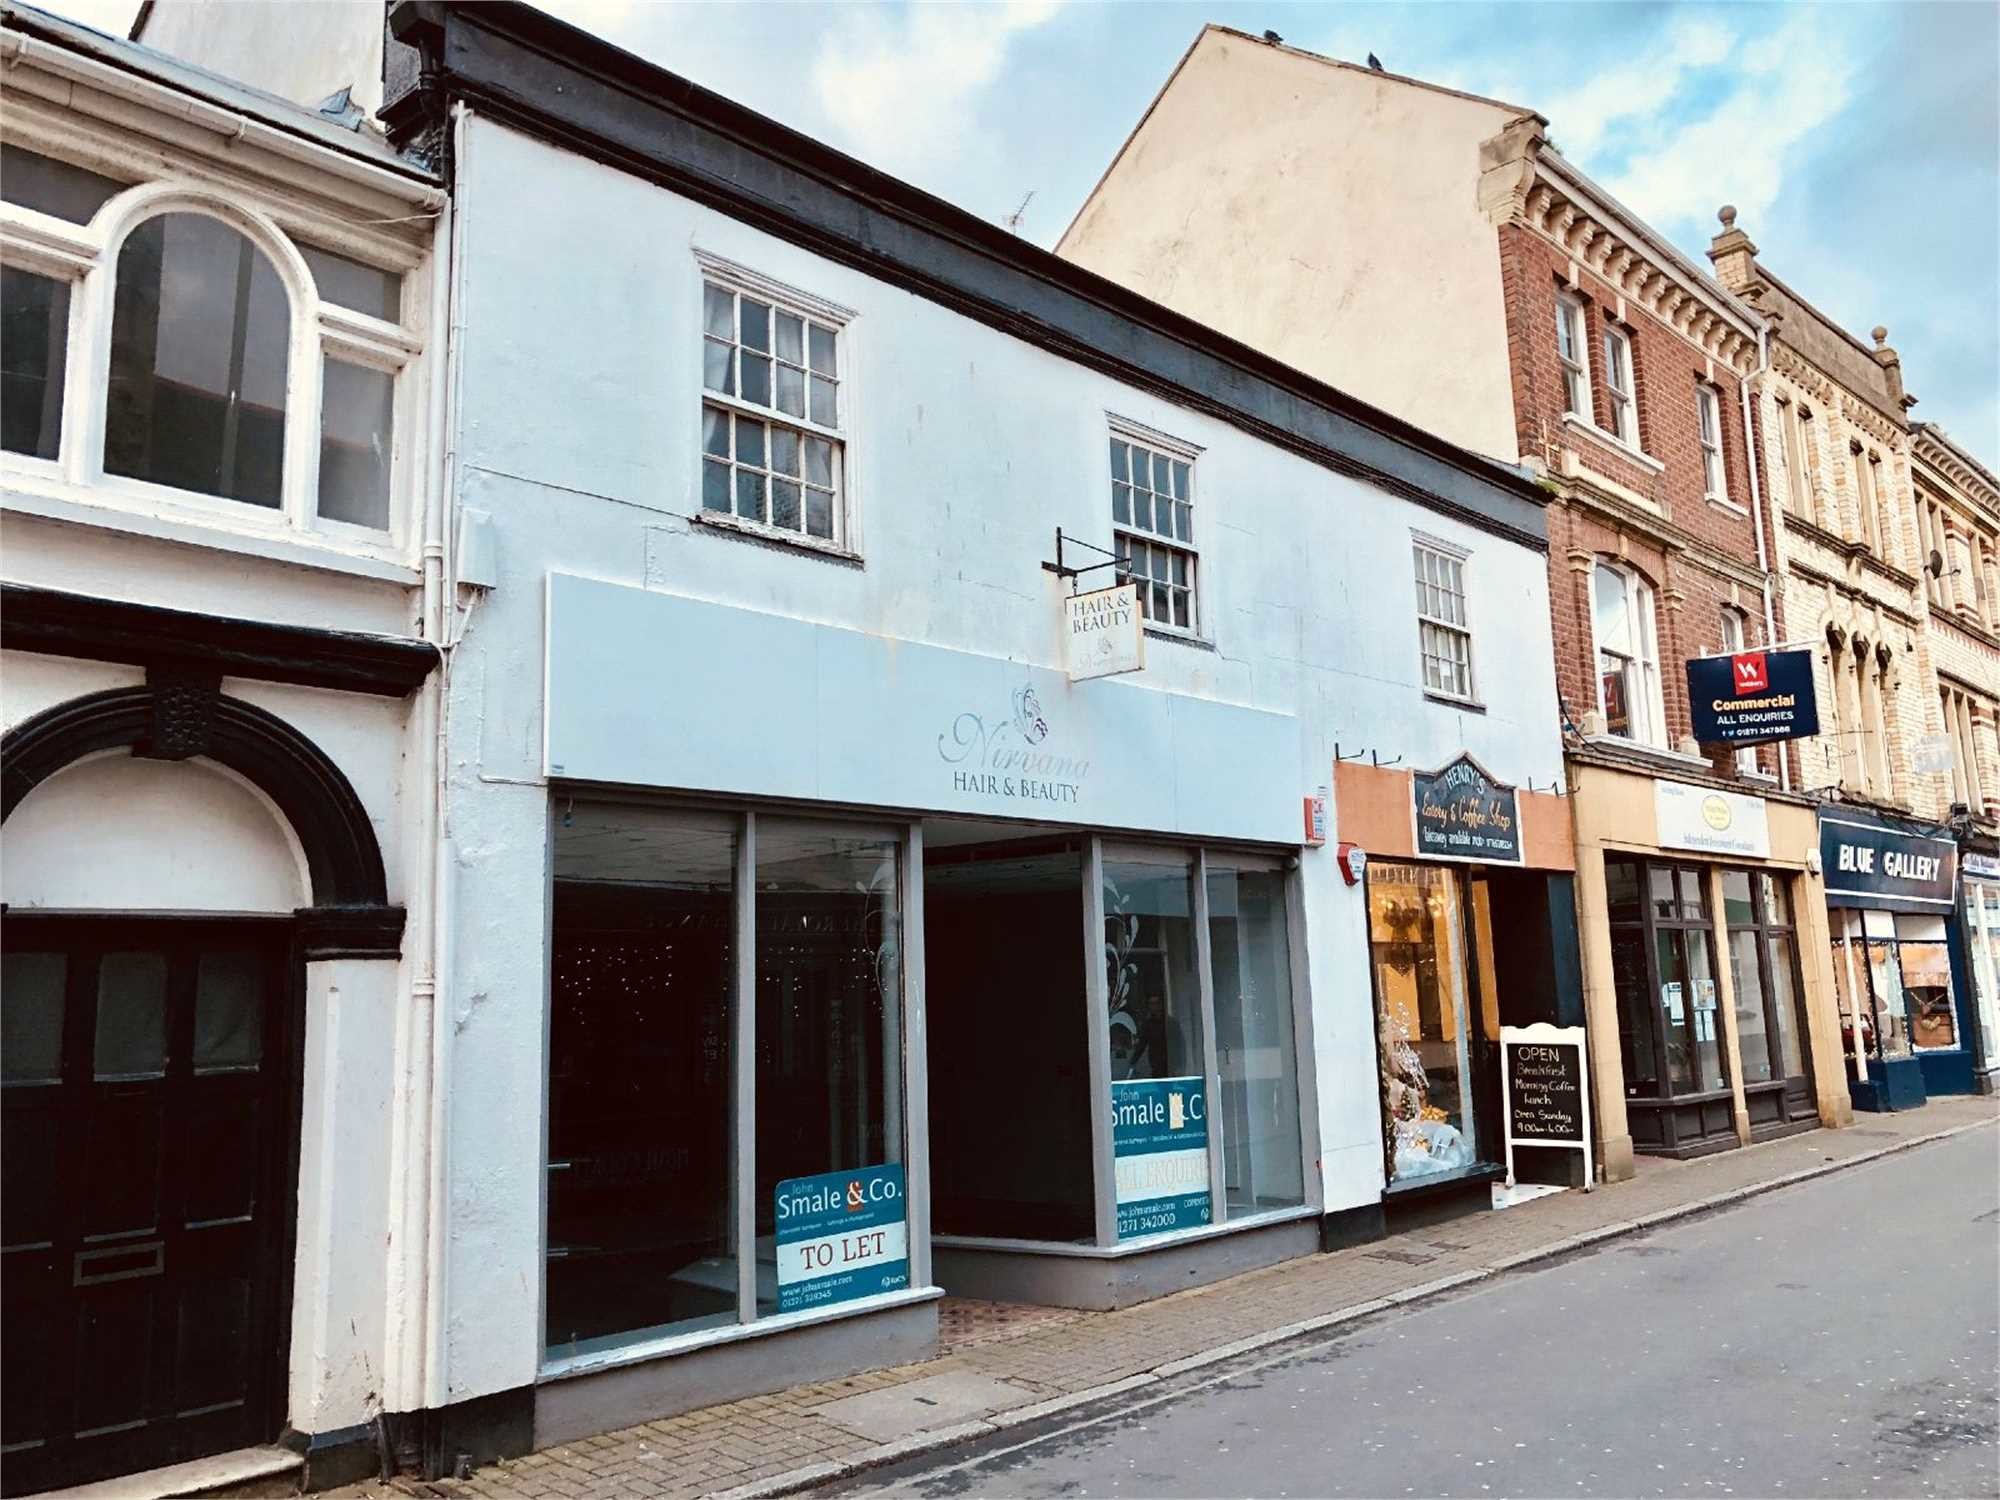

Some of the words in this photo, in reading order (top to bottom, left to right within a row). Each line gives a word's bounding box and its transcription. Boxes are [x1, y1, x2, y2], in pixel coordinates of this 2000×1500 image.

[1074, 595, 1113, 617] HAIR
[1117, 591, 1129, 607] &
[1073, 608, 1131, 634] BEAUTY
[1712, 694, 1795, 711] Commercial
[1717, 715, 1736, 725] ALL
[1739, 711, 1794, 723] ENQUIRIES
[938, 713, 1090, 777] Nirvana
[953, 771, 999, 795] HAIR
[1003, 777, 1016, 797] &
[1021, 778, 1079, 803] BEAUTY
[1445, 763, 1486, 795] HENRY'S
[1459, 796, 1486, 829] Coffee
[1489, 799, 1511, 832] Shop
[1839, 844, 1874, 874] BLUE
[1884, 851, 1940, 882] GALLERY
[1518, 1047, 1559, 1062] OPEN
[1120, 1089, 1140, 1102] John
[1538, 1110, 1571, 1123] Sunday
[778, 1186, 841, 1219] Smale
[847, 1181, 868, 1206] &
[870, 1178, 902, 1201] Co.
[792, 1182, 814, 1195] John
[1140, 1212, 1176, 1230] 342000
[800, 1243, 833, 1270] TO
[842, 1232, 885, 1262] LET
